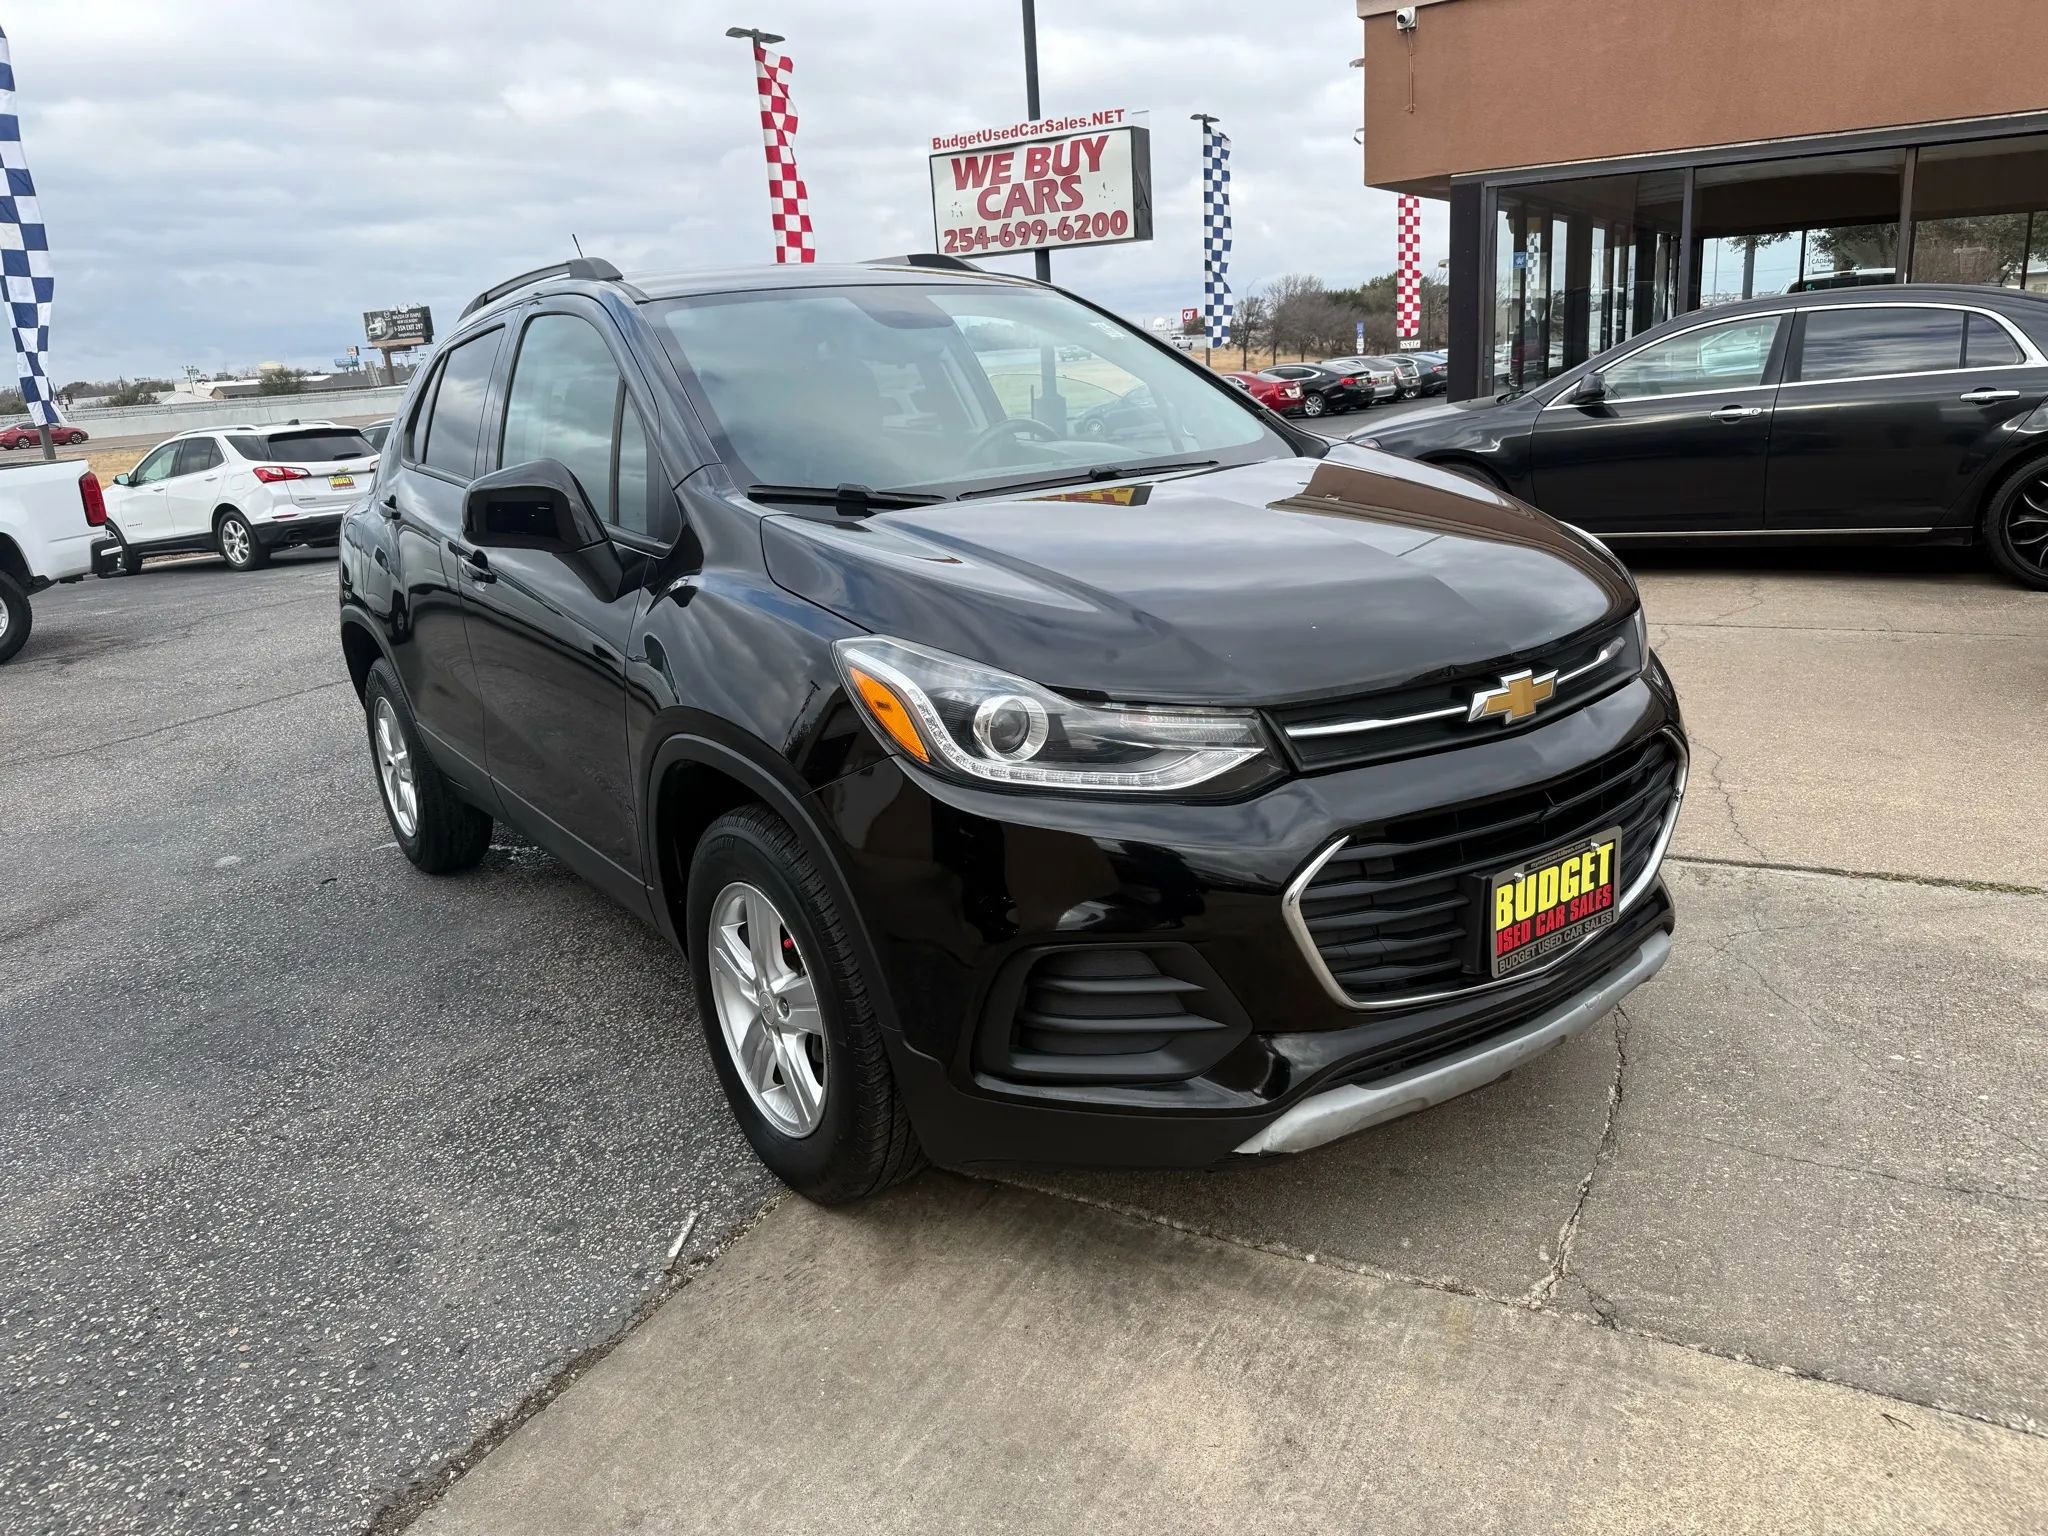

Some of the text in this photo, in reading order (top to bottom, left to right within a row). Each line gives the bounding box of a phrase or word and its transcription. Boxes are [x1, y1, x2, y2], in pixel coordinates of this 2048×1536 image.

[932, 108, 1125, 151] BudgetUsedCarSales.NET
[951, 135, 1110, 191] WE BUY
[977, 175, 1084, 221] CARS
[944, 210, 1129, 254] 254-699-6200
[1496, 842, 1614, 931] BUDGET
[1496, 884, 1612, 957] USED CAR SALES
[1499, 912, 1612, 972] BUDGET USED CAR SALES
